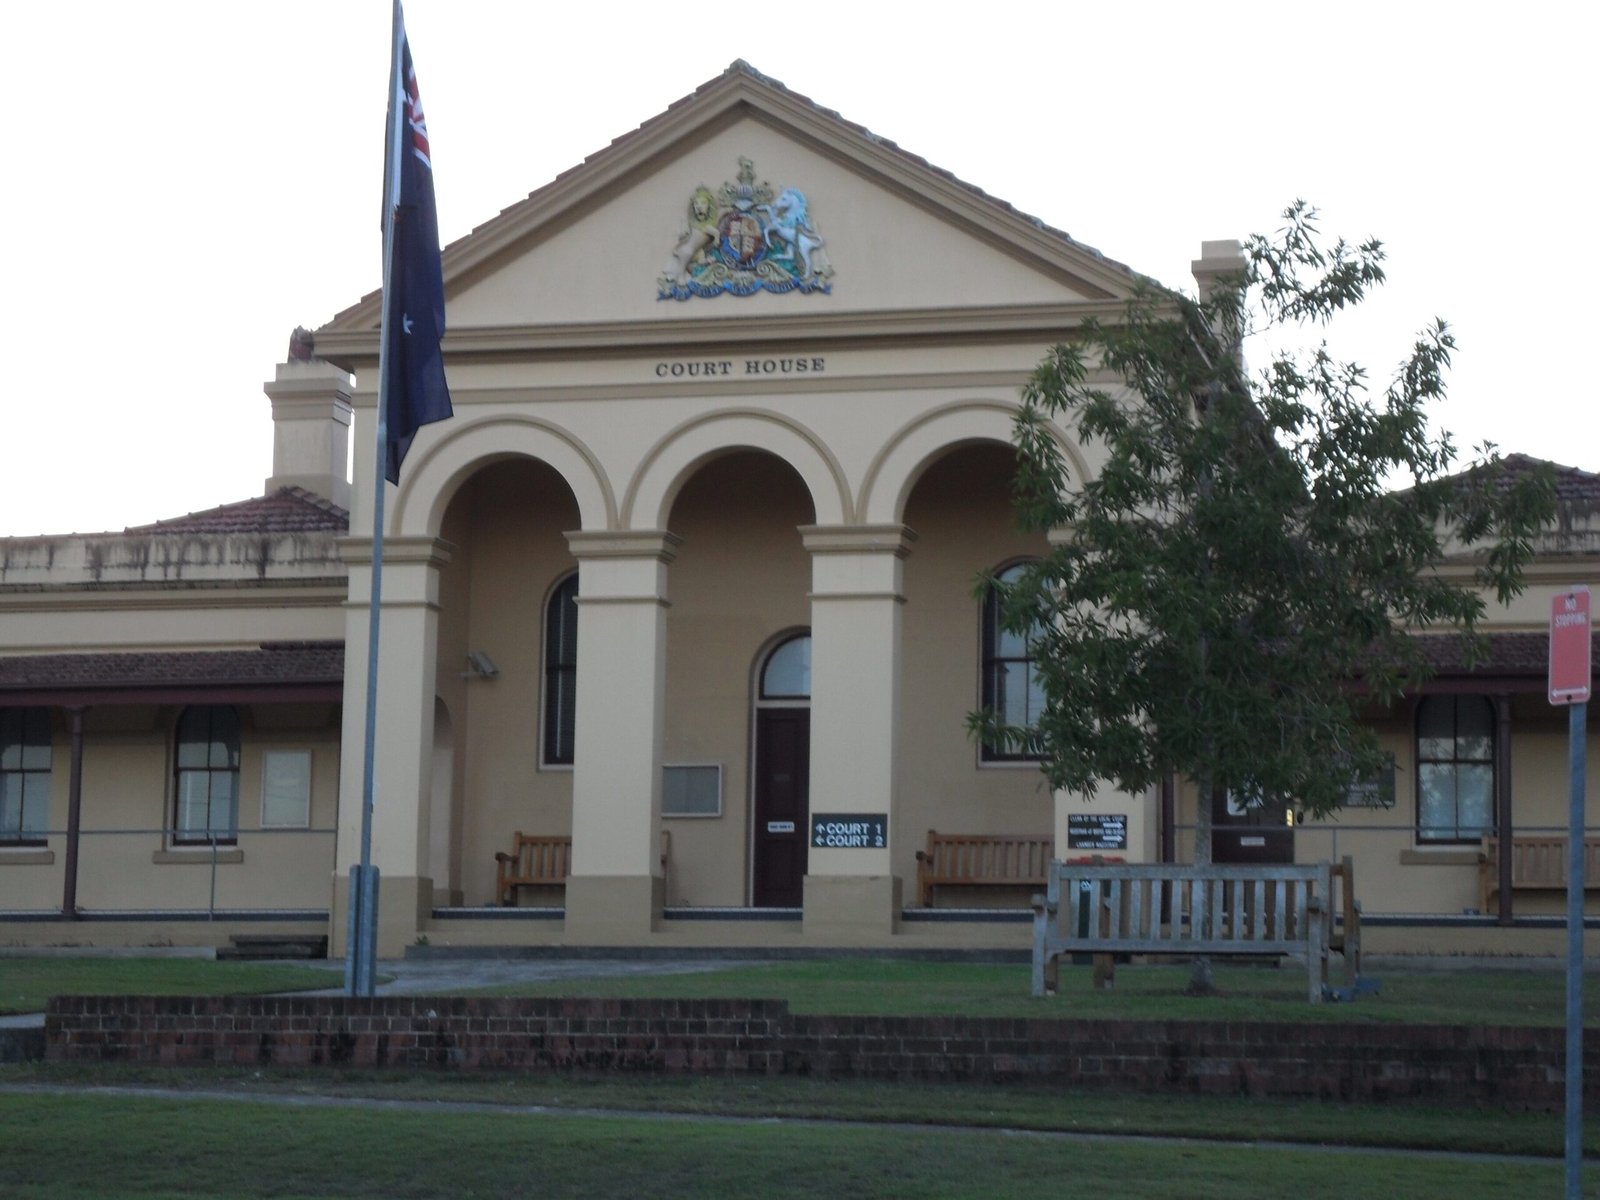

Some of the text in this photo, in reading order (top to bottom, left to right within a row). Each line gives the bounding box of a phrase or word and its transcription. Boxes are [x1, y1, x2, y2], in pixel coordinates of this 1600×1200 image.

[655, 357, 826, 378] COURT HOUSE
[1565, 598, 1577, 611] NO
[1555, 612, 1586, 628] STOPPING
[826, 822, 882, 834] COURT 1
[826, 834, 884, 847] COURT 2
